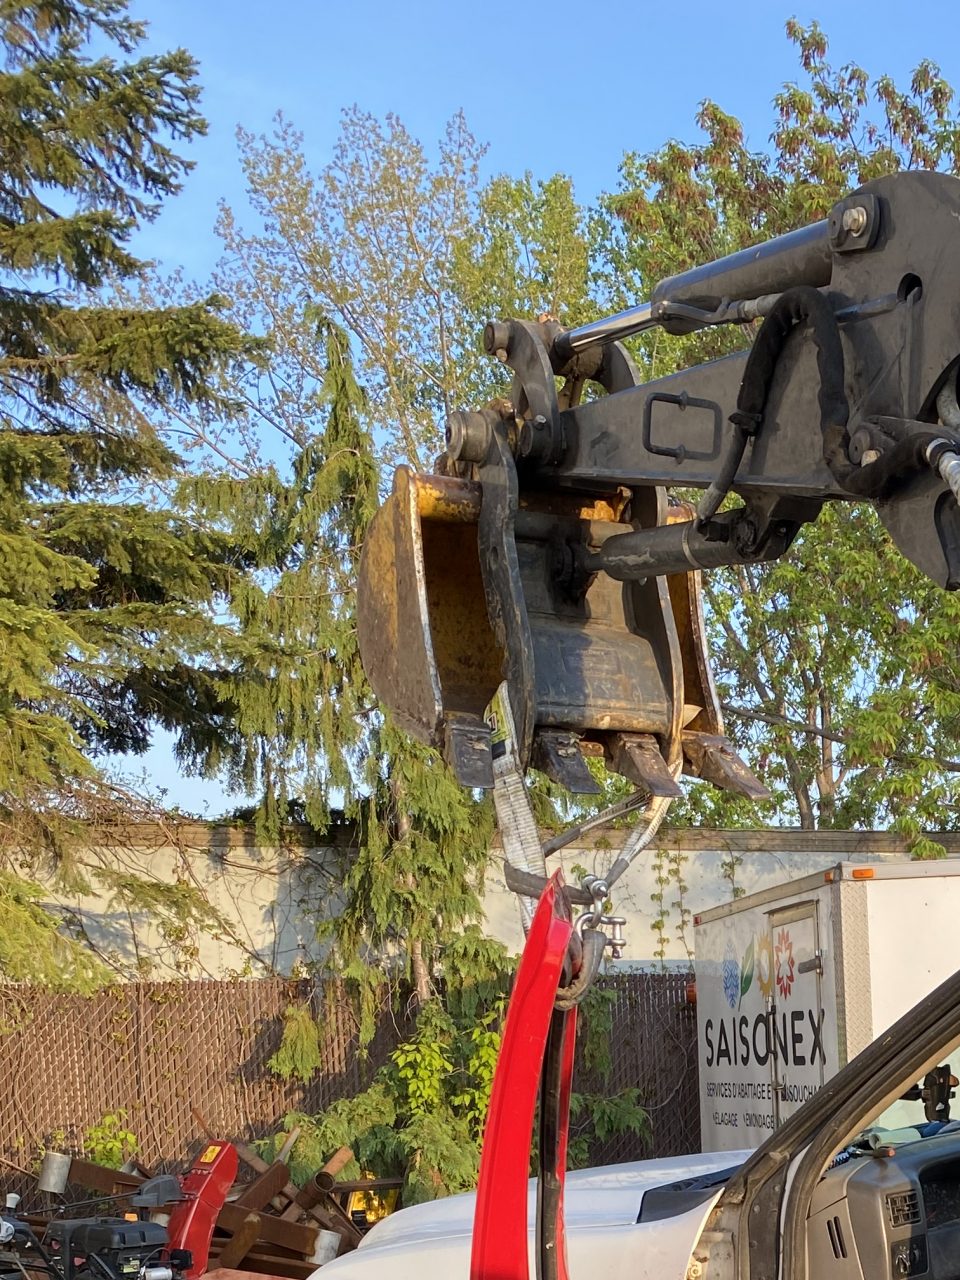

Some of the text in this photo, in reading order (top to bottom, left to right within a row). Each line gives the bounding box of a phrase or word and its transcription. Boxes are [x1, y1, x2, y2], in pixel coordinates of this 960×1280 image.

[705, 1008, 827, 1068] SAISONEX
[706, 1082, 731, 1099] SERVICES
[732, 1083, 767, 1101] D'ABATTAGE
